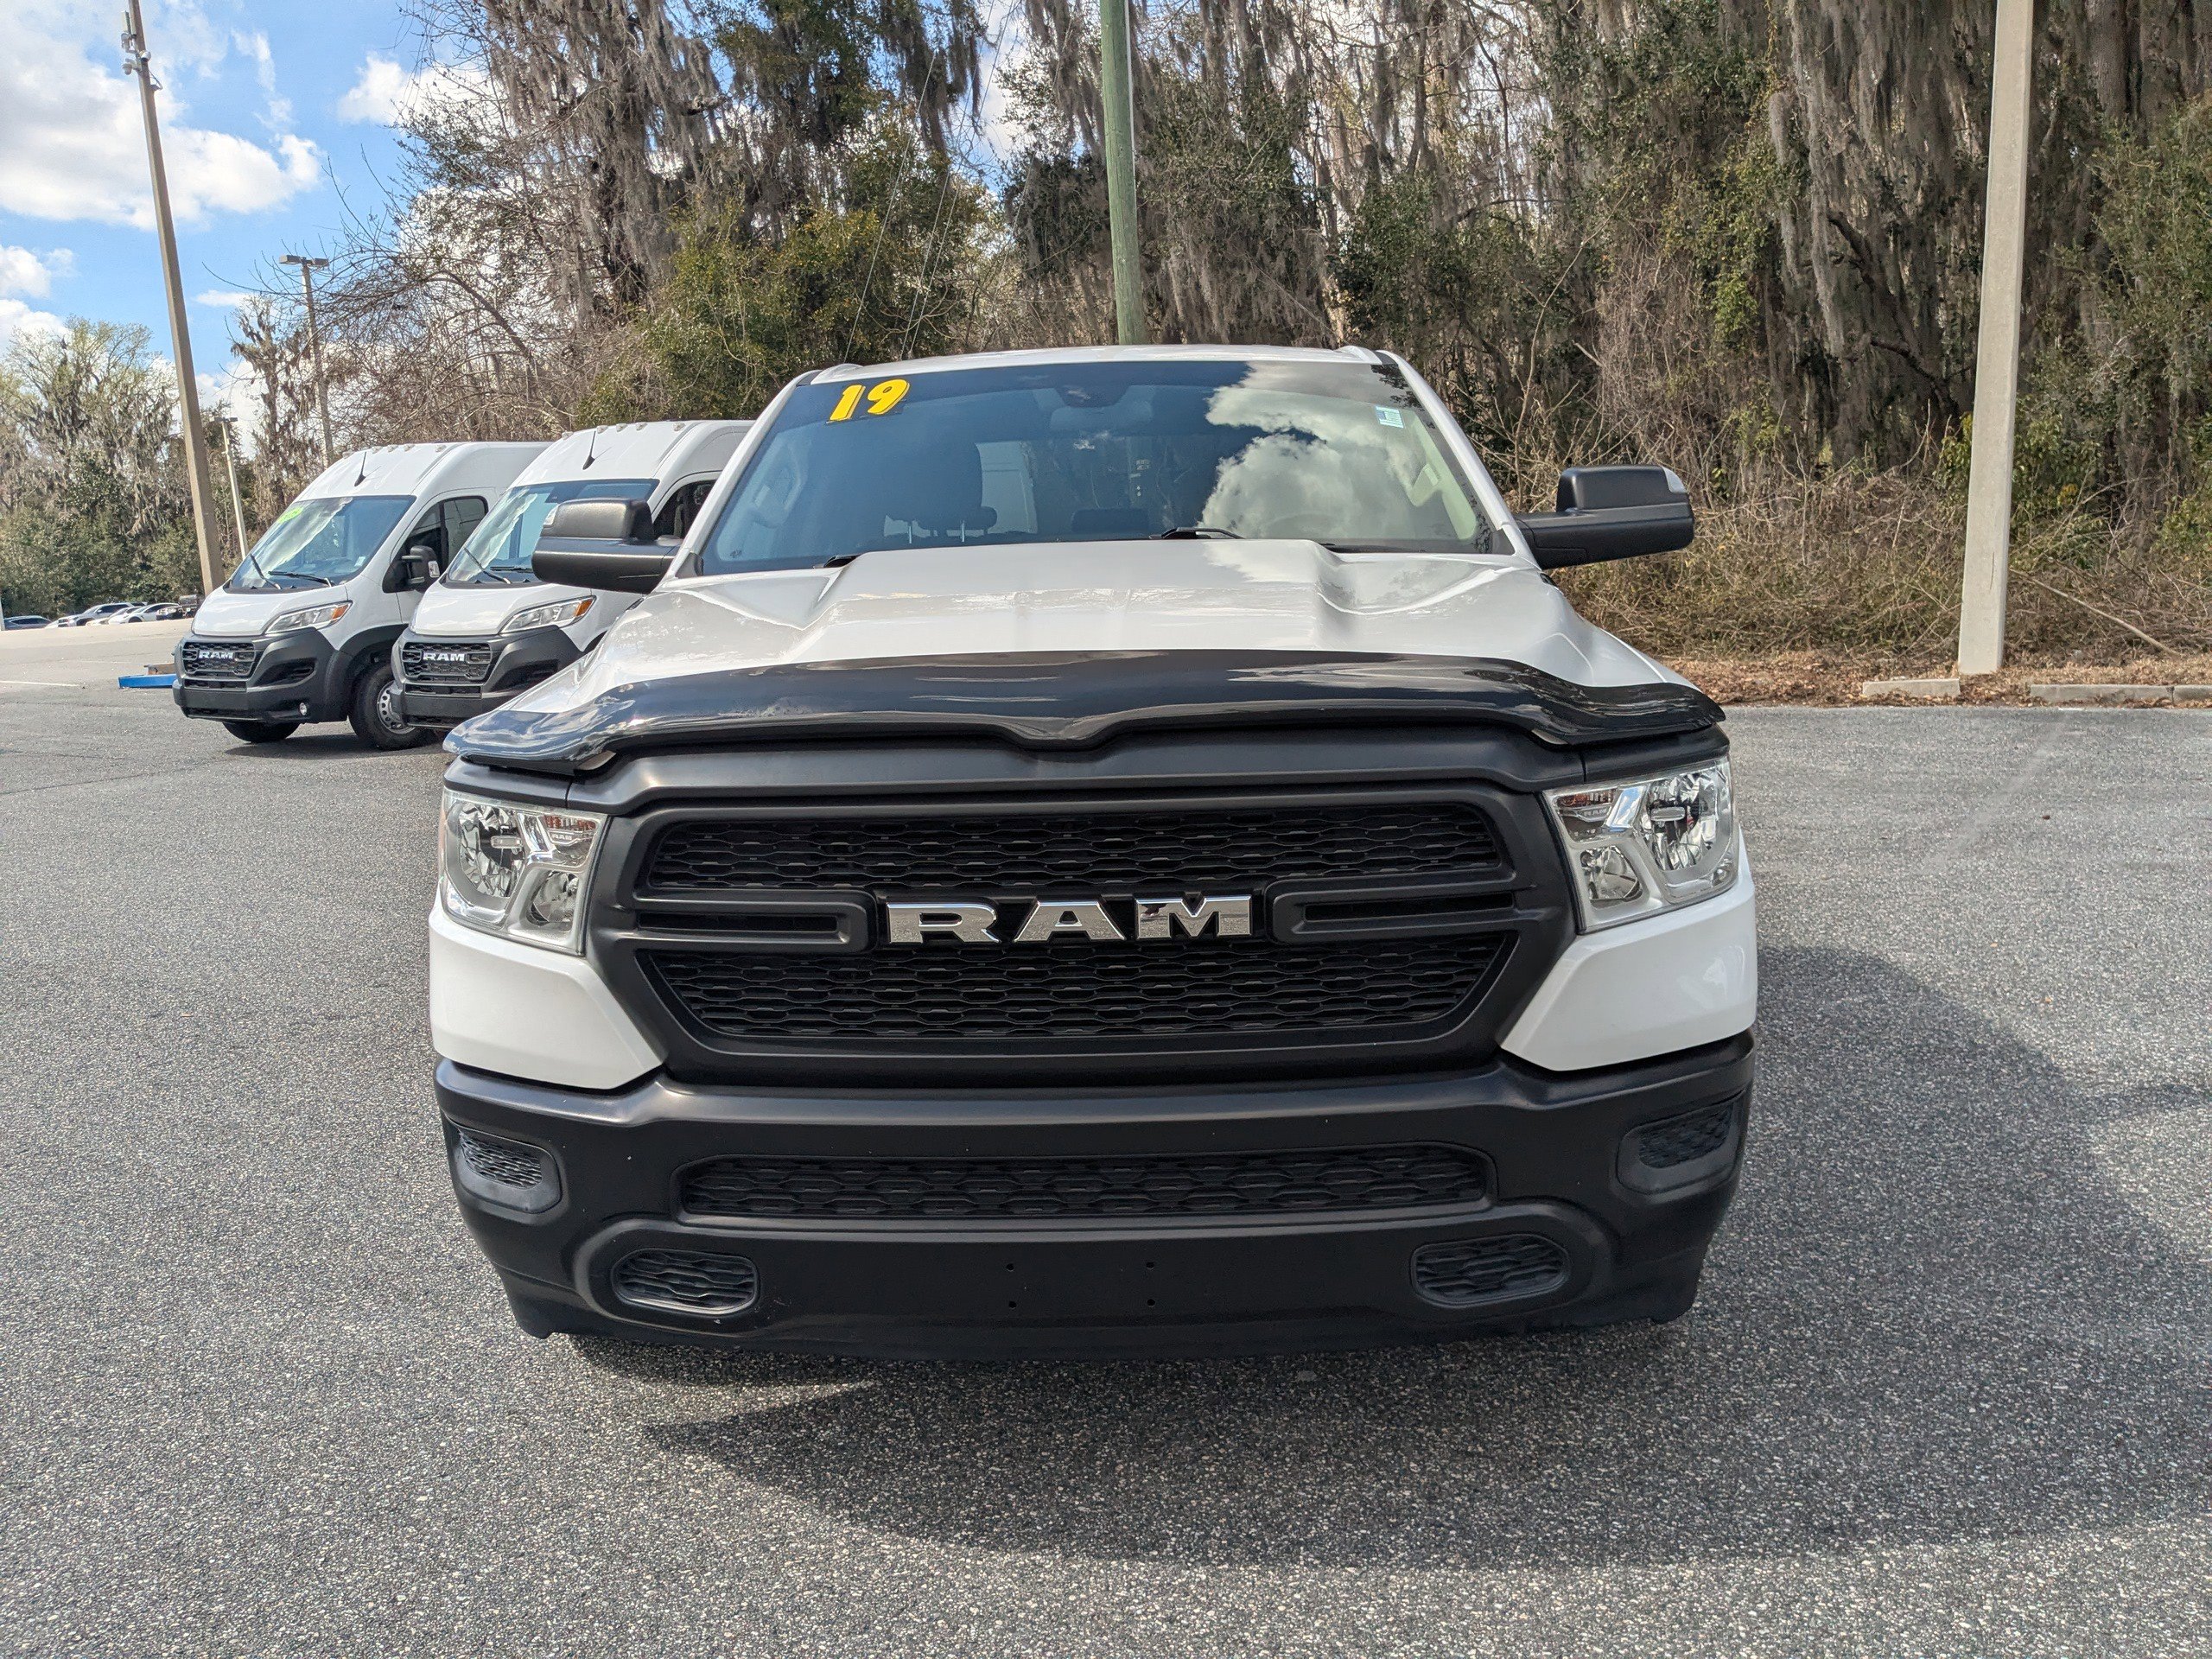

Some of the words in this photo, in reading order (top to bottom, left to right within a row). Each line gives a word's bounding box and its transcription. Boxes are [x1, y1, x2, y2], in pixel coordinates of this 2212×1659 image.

[830, 378, 910, 422] 19
[198, 651, 233, 659] RAM
[423, 652, 465, 662] RAM
[887, 895, 1252, 944] RAM
